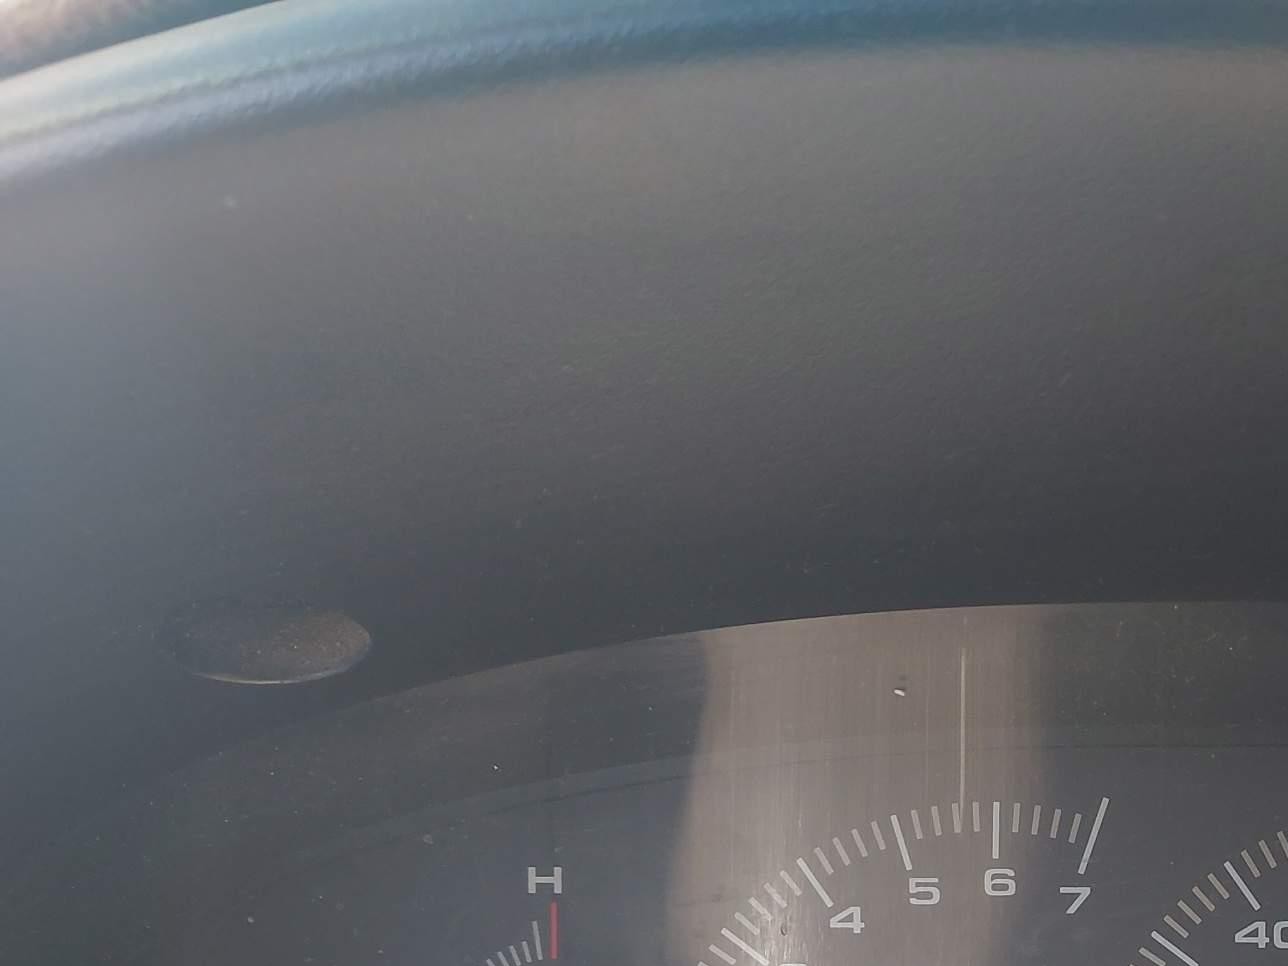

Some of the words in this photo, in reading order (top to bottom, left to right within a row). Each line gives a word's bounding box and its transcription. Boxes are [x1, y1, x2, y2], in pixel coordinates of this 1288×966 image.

[528, 866, 562, 894] H
[909, 877, 940, 905] 5
[984, 868, 1016, 896] 6
[1059, 887, 1091, 914] 7
[829, 906, 864, 933] 4
